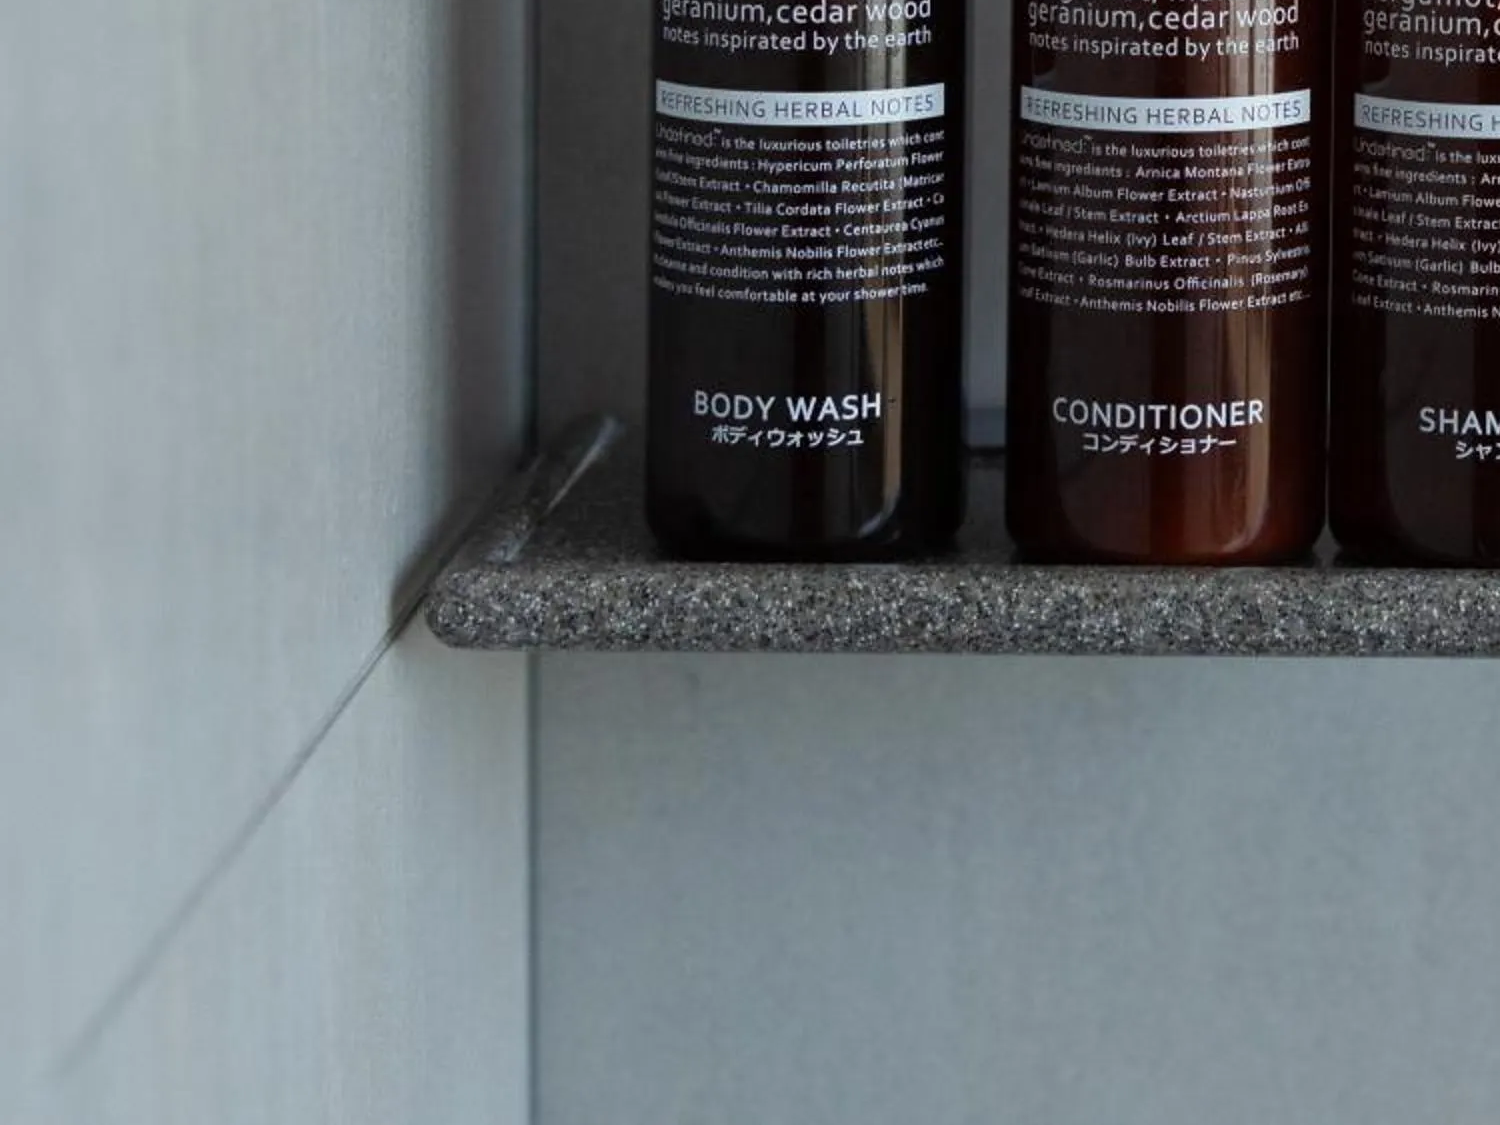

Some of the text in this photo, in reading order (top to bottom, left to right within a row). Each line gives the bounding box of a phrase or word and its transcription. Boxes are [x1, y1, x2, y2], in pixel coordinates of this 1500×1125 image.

[663, 25, 932, 55] notes inspirated by the earth
[1029, 31, 1300, 61] notes inspirated by the earth
[1364, 38, 1409, 58] notes
[660, 89, 935, 118] REFRESHING HERBAL NOTES
[1025, 94, 1302, 125] REFRESHING HERBAL NOTES
[1360, 103, 1484, 132] REFRESHING
[721, 133, 921, 152] is the luxurious toiletries which
[1092, 142, 1102, 155] is
[1105, 143, 1127, 156] the
[1131, 143, 1195, 158] luxurious
[758, 158, 832, 174] Hypericum
[835, 156, 909, 172] Perforatum
[911, 151, 944, 166] Flower
[1435, 150, 1447, 164] is
[1450, 150, 1473, 164] the
[1135, 166, 1180, 179] Arnica
[1185, 165, 1245, 179] Montana
[1247, 161, 1285, 176] Flower
[1395, 168, 1467, 184] ingredients
[700, 176, 895, 194] Extract Chamomilla Recutita
[1073, 184, 1113, 199] Album
[1117, 187, 1163, 202] Flower
[1167, 188, 1218, 202] Extract
[691, 196, 923, 216] Extract Cordata Flower Extract
[1415, 190, 1459, 206] Album
[1074, 206, 1107, 220] Stem
[1109, 208, 1159, 224] Extract
[1175, 210, 1230, 224] Arctium
[1233, 207, 1271, 222] Lappa
[1415, 213, 1451, 227] Stem
[733, 222, 779, 237] Flower
[781, 224, 831, 238] Extract
[843, 221, 909, 236] Centaurea
[1087, 227, 1286, 249] Helix (Ivy) Leaf Stem Extract
[720, 241, 923, 259] Anthemis Nobilis Flower Extract
[1431, 236, 1466, 251] Helix
[709, 264, 769, 280] condition
[771, 266, 803, 281] with
[806, 266, 833, 280] rich
[836, 264, 879, 279] herbal
[881, 262, 914, 277] notes
[915, 255, 944, 272] which
[1071, 250, 1263, 268] (Garlic) Bulb Extract Pinus
[1415, 258, 1463, 275] (Garlic)
[1088, 274, 1169, 290] Rosmarinus
[1173, 276, 1244, 291] Officinalis
[1377, 274, 1417, 292] Extract
[717, 286, 798, 303] comfortable
[801, 291, 816, 303] at
[819, 289, 851, 306] your
[853, 285, 899, 300] shower
[1080, 295, 1144, 312] Anthemis
[1146, 299, 1195, 313] Nobilis
[1199, 298, 1244, 313] Flower
[1247, 292, 1287, 308] Extract
[1373, 295, 1413, 314] Extract
[1423, 302, 1488, 317] Anthemis
[693, 389, 882, 422] BODY WASH
[1052, 396, 1265, 430] CONDITIONER
[711, 424, 865, 449] ボディウォッシュ
[1082, 432, 1237, 456] コンディショナー
